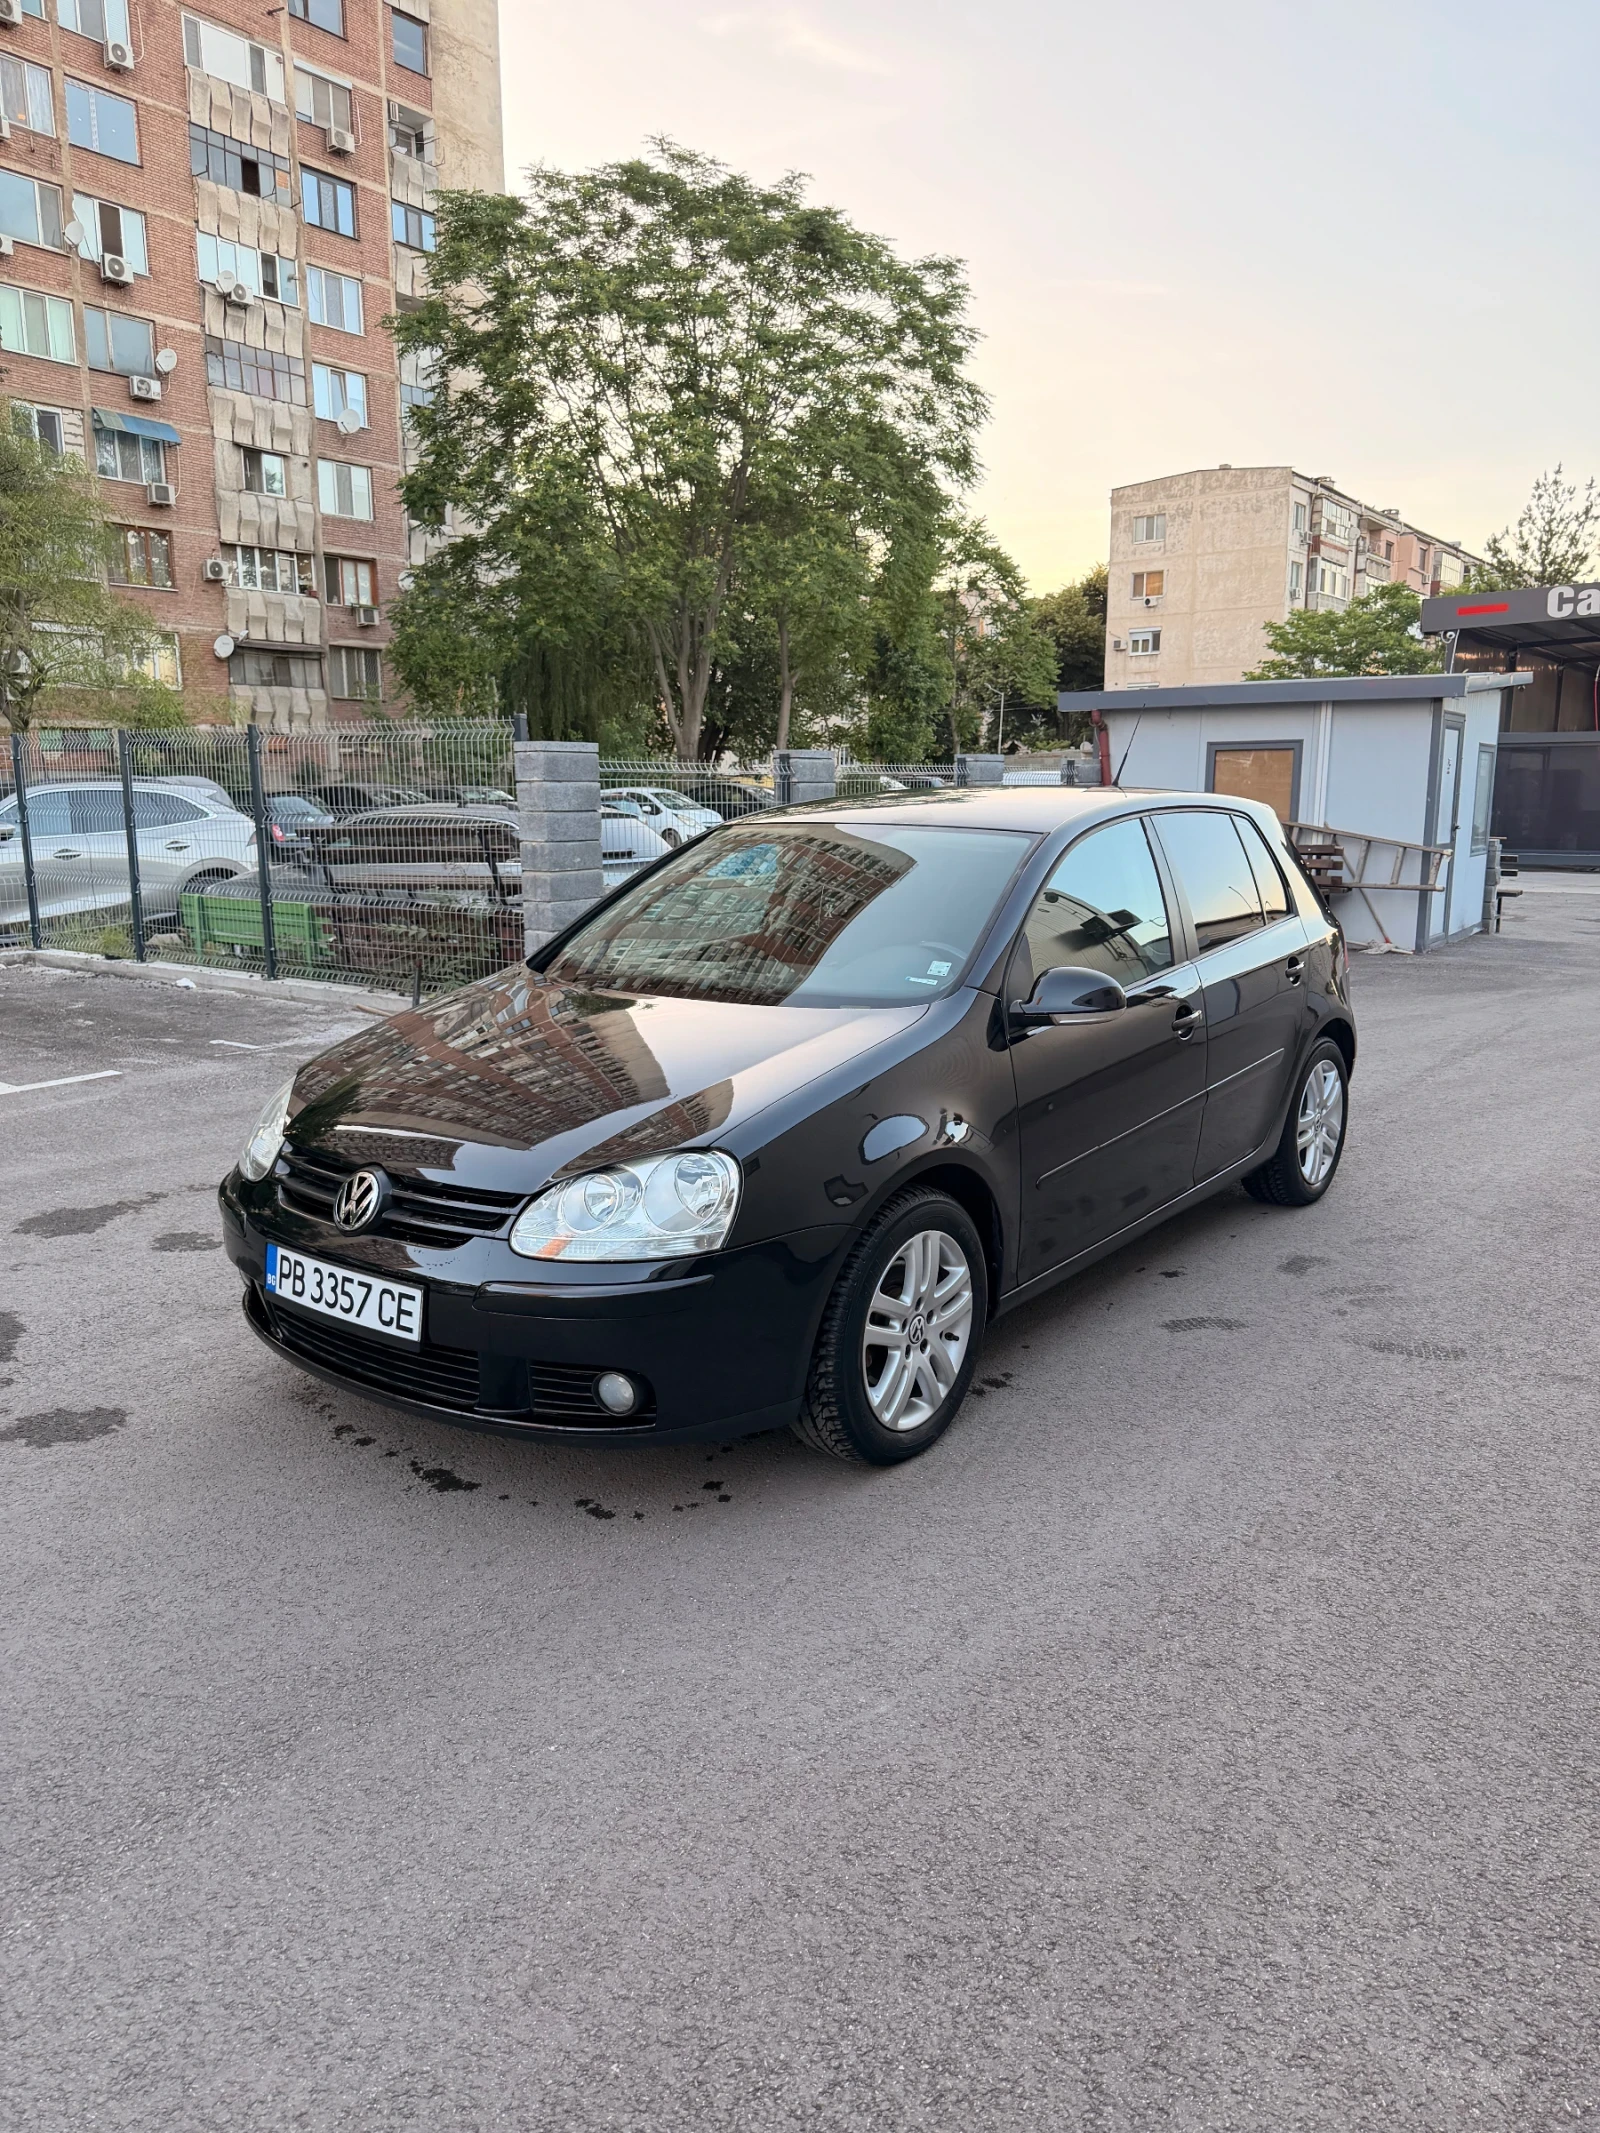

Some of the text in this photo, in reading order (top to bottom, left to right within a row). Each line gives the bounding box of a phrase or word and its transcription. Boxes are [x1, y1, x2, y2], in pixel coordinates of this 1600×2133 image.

[267, 1273, 276, 1286] BG
[279, 1254, 416, 1334] PB 3357 CE
